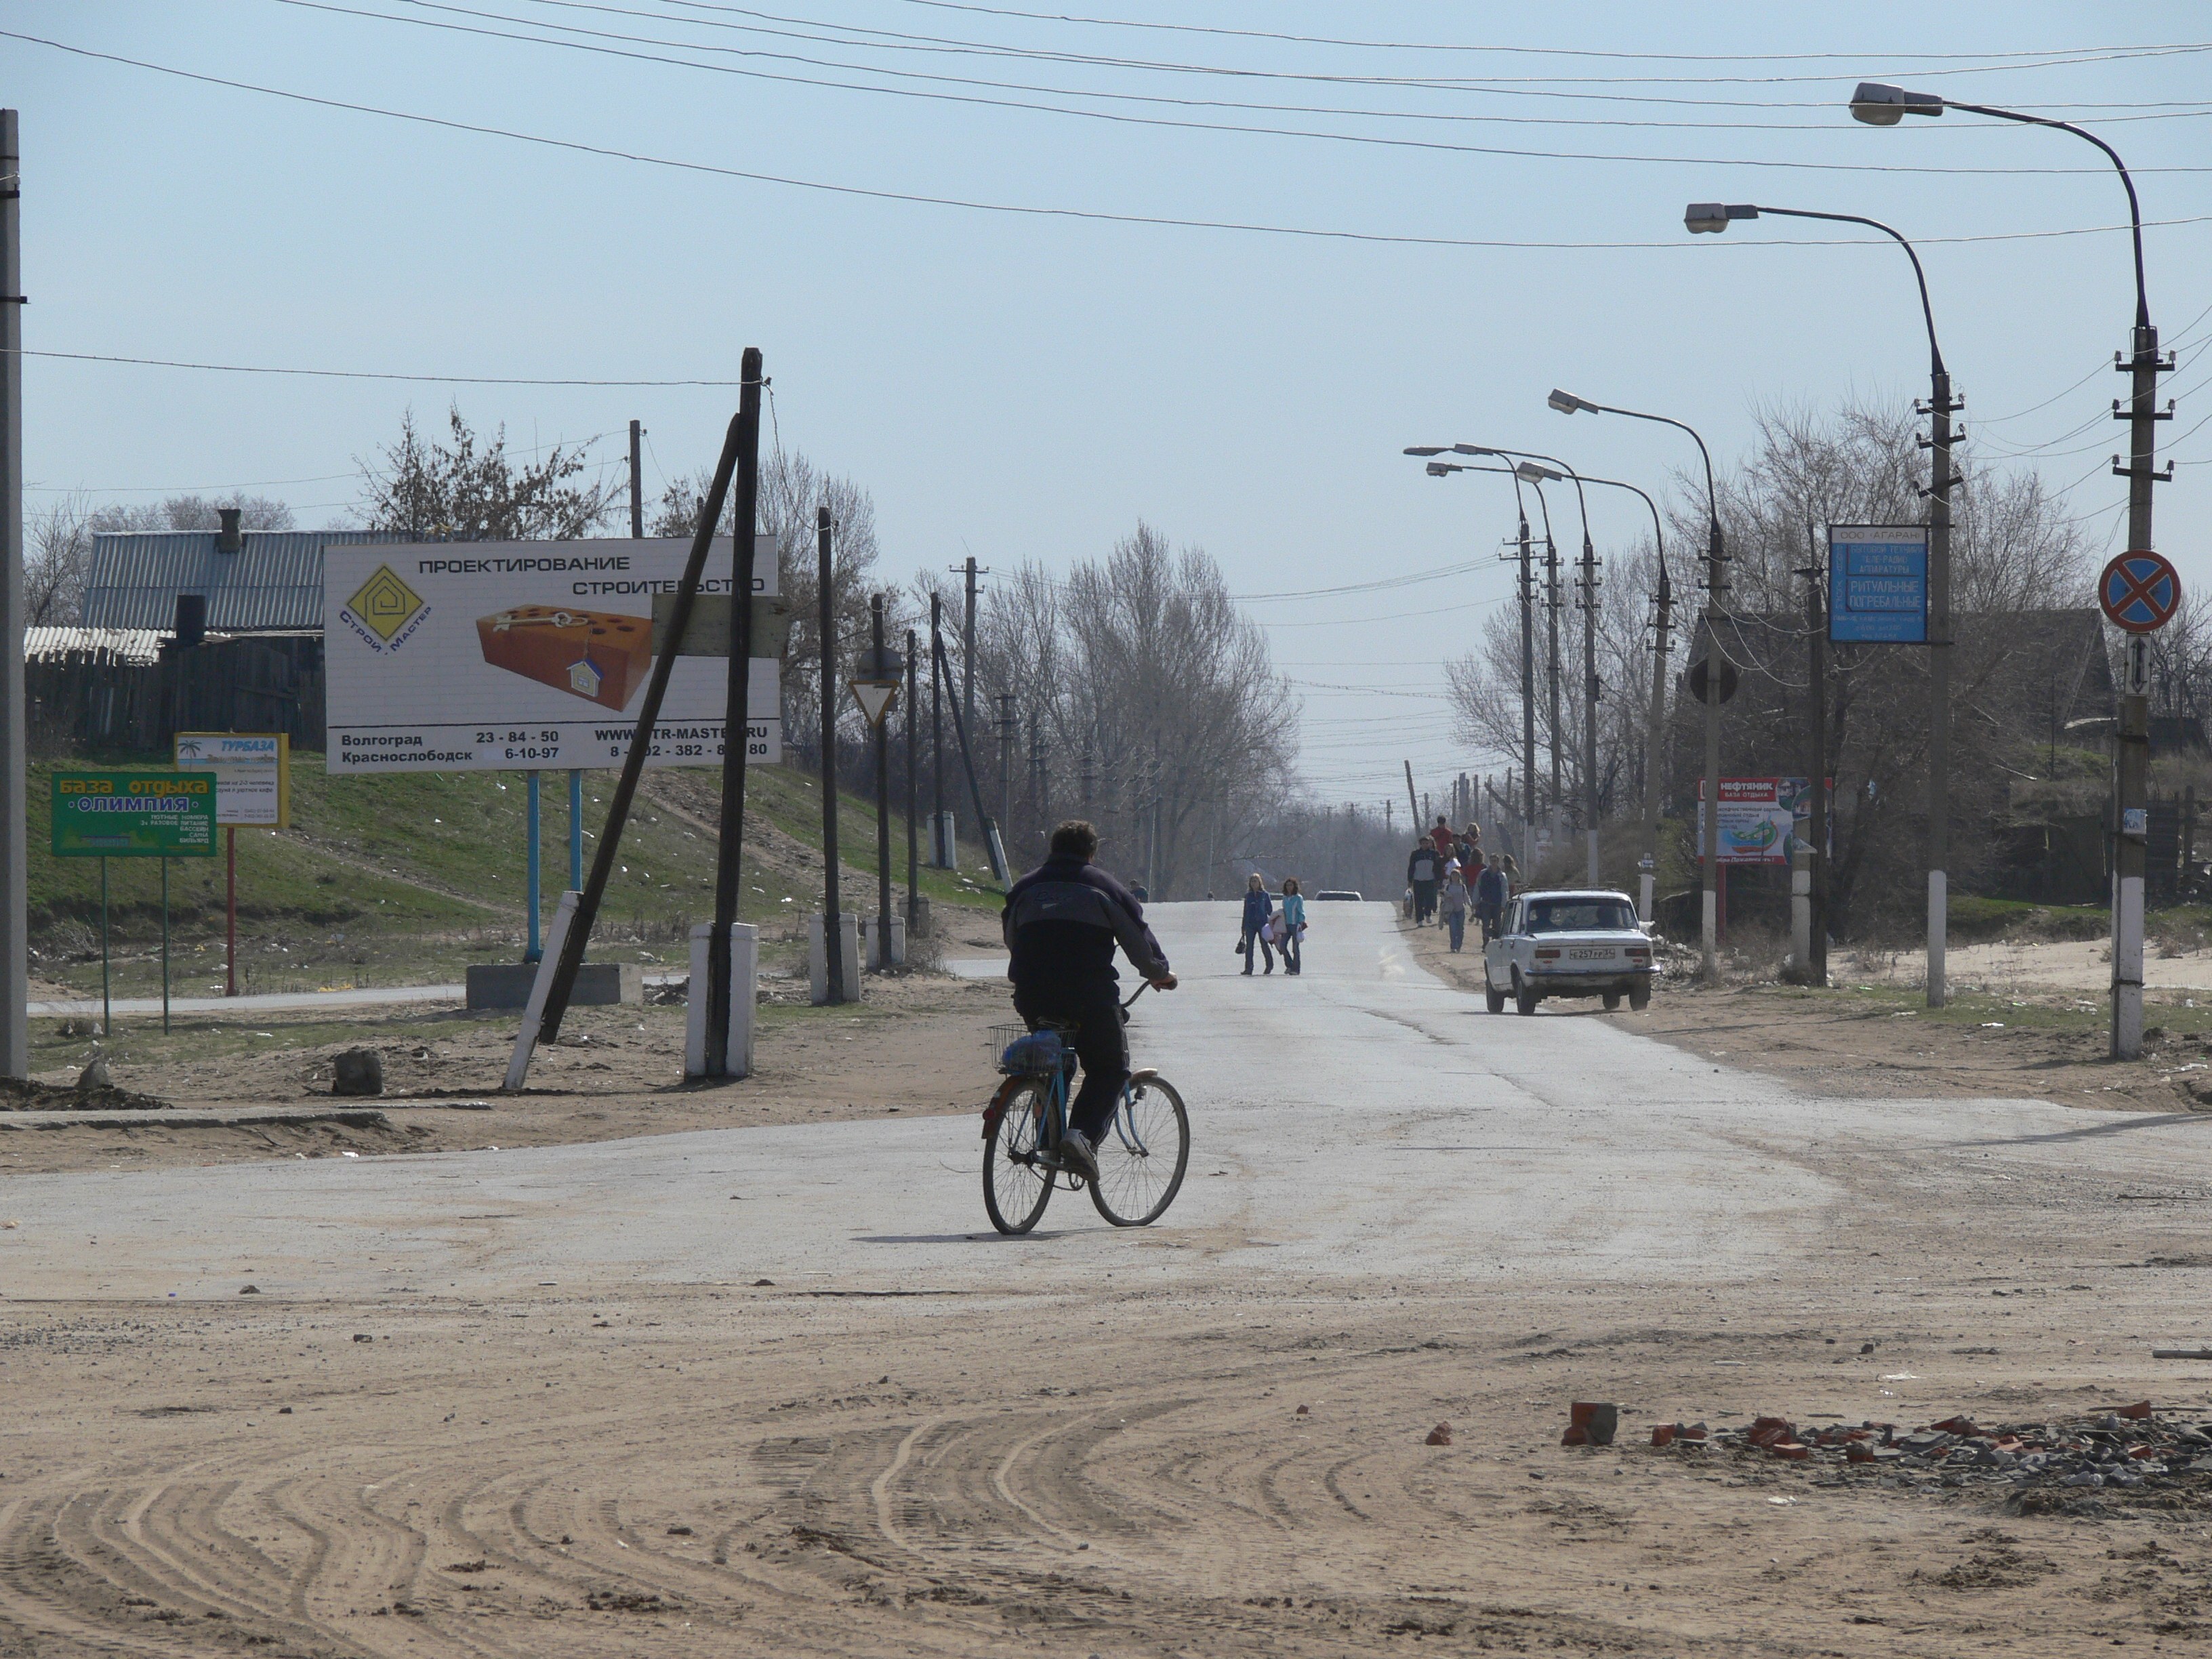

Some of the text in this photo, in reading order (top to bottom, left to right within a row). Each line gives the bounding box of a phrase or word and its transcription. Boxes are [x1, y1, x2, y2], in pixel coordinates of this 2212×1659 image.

[1840, 531, 1865, 539] ООО
[419, 556, 630, 575] ПРОЕКТИРОВАНИЕ
[573, 578, 765, 596] СТРОИТЕЬСТО
[1850, 580, 1919, 593] РИТУАЛЬНЫЕ
[1849, 595, 1922, 608] ПОГРЕБАЛЬНЫЕ
[595, 726, 768, 741] WWWTR-MASTERU
[221, 740, 275, 752] ТУРБАЗА
[341, 735, 423, 747] Волгоград
[342, 747, 560, 764] Краснослободск 6-10-97
[128, 779, 209, 798] отдыха
[1721, 782, 1773, 792] НЕФТЯНИК
[77, 796, 190, 813] ОЛИМПИЯ
